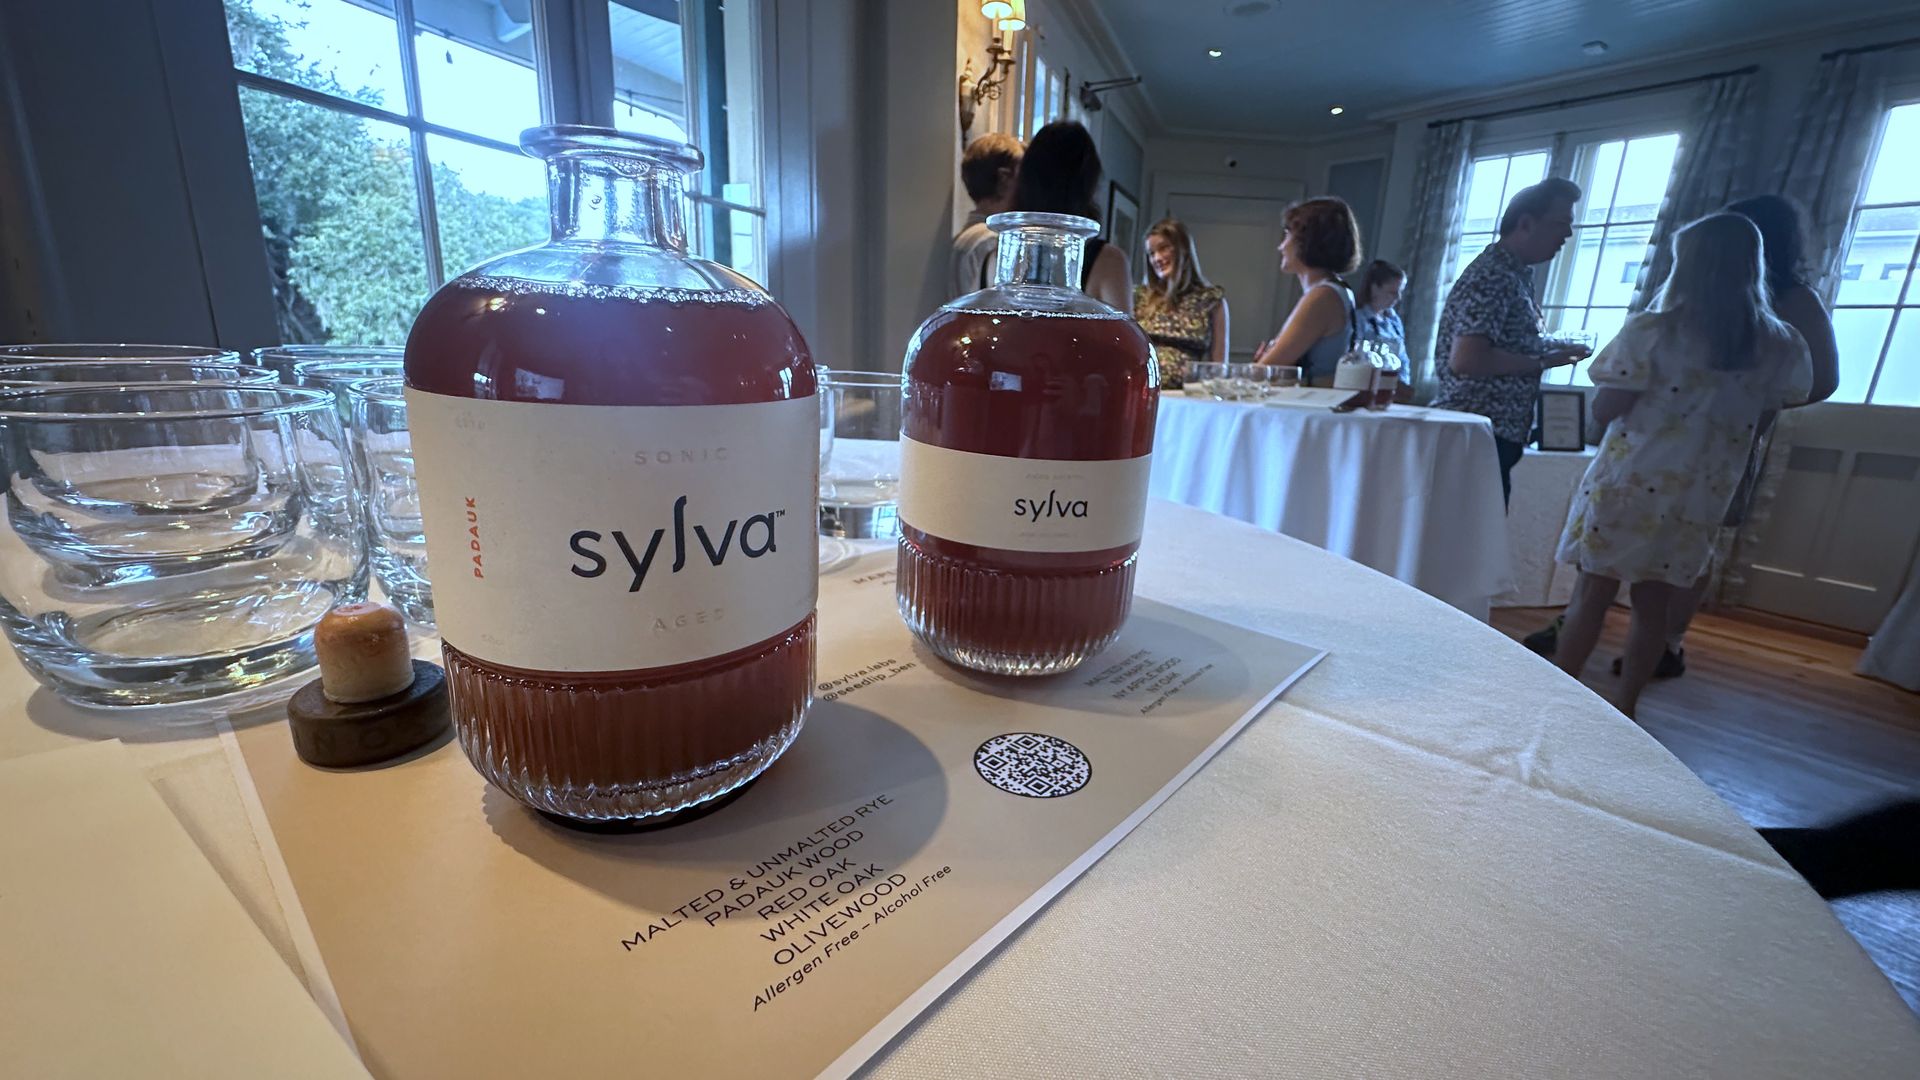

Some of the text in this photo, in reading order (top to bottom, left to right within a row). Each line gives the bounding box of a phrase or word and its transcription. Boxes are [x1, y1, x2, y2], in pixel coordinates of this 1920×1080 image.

[634, 447, 729, 466] SONIC
[465, 496, 484, 579] PADAUK
[1014, 490, 1088, 522] sylva
[853, 570, 898, 584] MAPL
[652, 607, 726, 632] AGED
[818, 658, 897, 691] @sylva.labs
[823, 662, 916, 701] @seedlip_ben
[621, 794, 894, 952] MALTED & UNMALTED RYE
[704, 829, 864, 927] PADAUK WOOD
[757, 857, 857, 921] RED OAK
[760, 863, 884, 943] WHITE OAK
[752, 955, 823, 1012] Allergen
[824, 929, 860, 958] Free
[873, 885, 923, 925] Alcohol
[922, 865, 952, 888] Free
[773, 873, 906, 965] OLIVEWOOD
